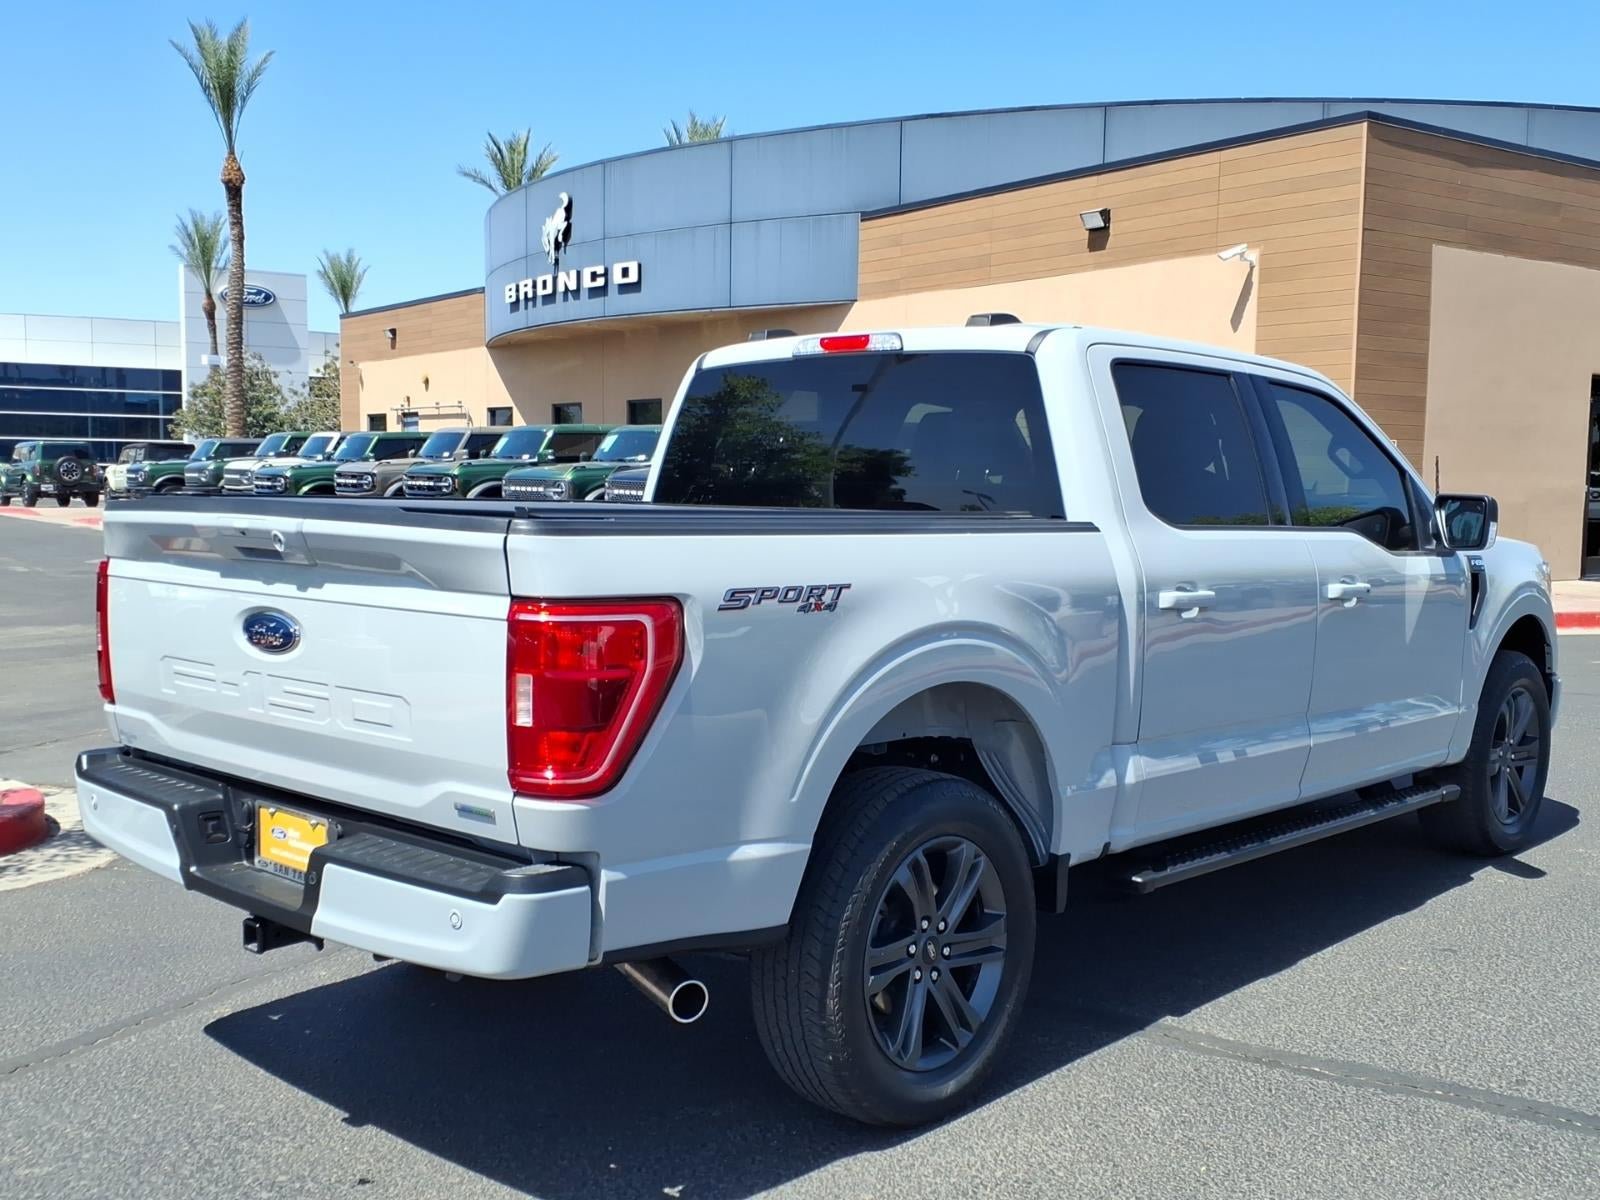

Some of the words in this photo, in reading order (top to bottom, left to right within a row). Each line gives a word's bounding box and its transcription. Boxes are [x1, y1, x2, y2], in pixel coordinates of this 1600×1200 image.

[505, 261, 638, 303] BRONCO
[718, 583, 851, 611] SPORT
[160, 655, 412, 743] F-150
